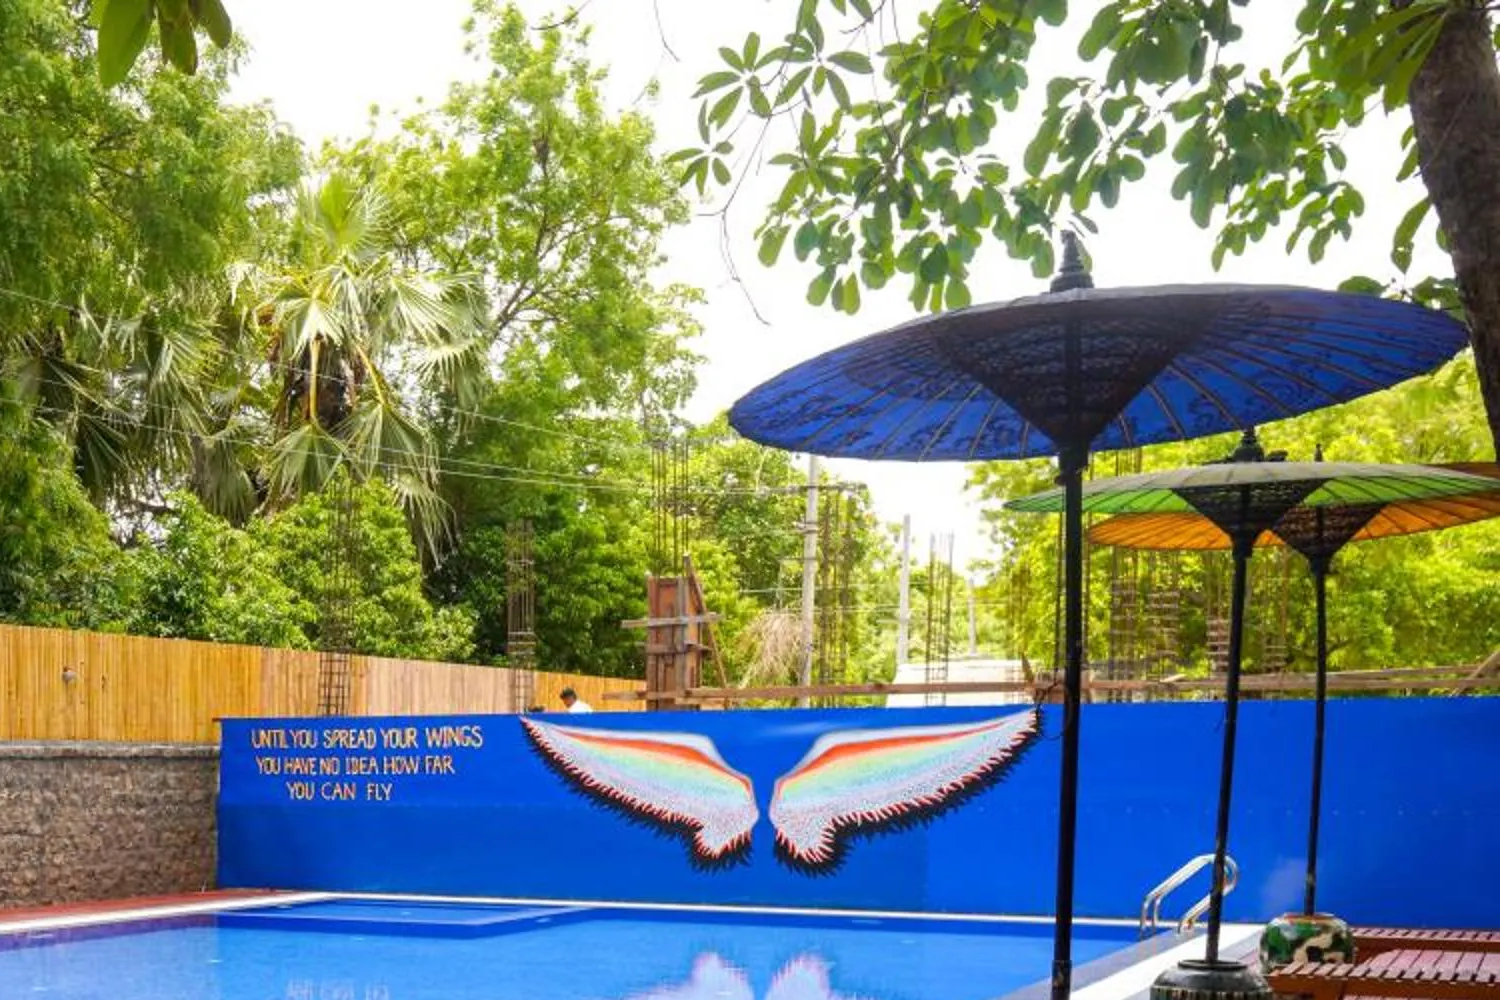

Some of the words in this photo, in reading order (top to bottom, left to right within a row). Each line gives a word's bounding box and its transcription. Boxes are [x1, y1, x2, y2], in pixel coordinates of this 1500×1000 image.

[251, 729, 290, 749] UNTIL
[289, 729, 318, 749] YOU
[323, 728, 376, 749] SPREAD
[381, 728, 418, 749] YOUR
[425, 726, 484, 748] WINGS
[256, 757, 281, 775] YOU
[284, 757, 316, 775] HAVE
[319, 757, 340, 775] NO
[345, 757, 378, 775] IDEA
[383, 756, 419, 775] HOW
[424, 755, 455, 774] FAR
[286, 783, 315, 800] YOU
[320, 783, 356, 800] CAN
[366, 783, 393, 801] FLY
